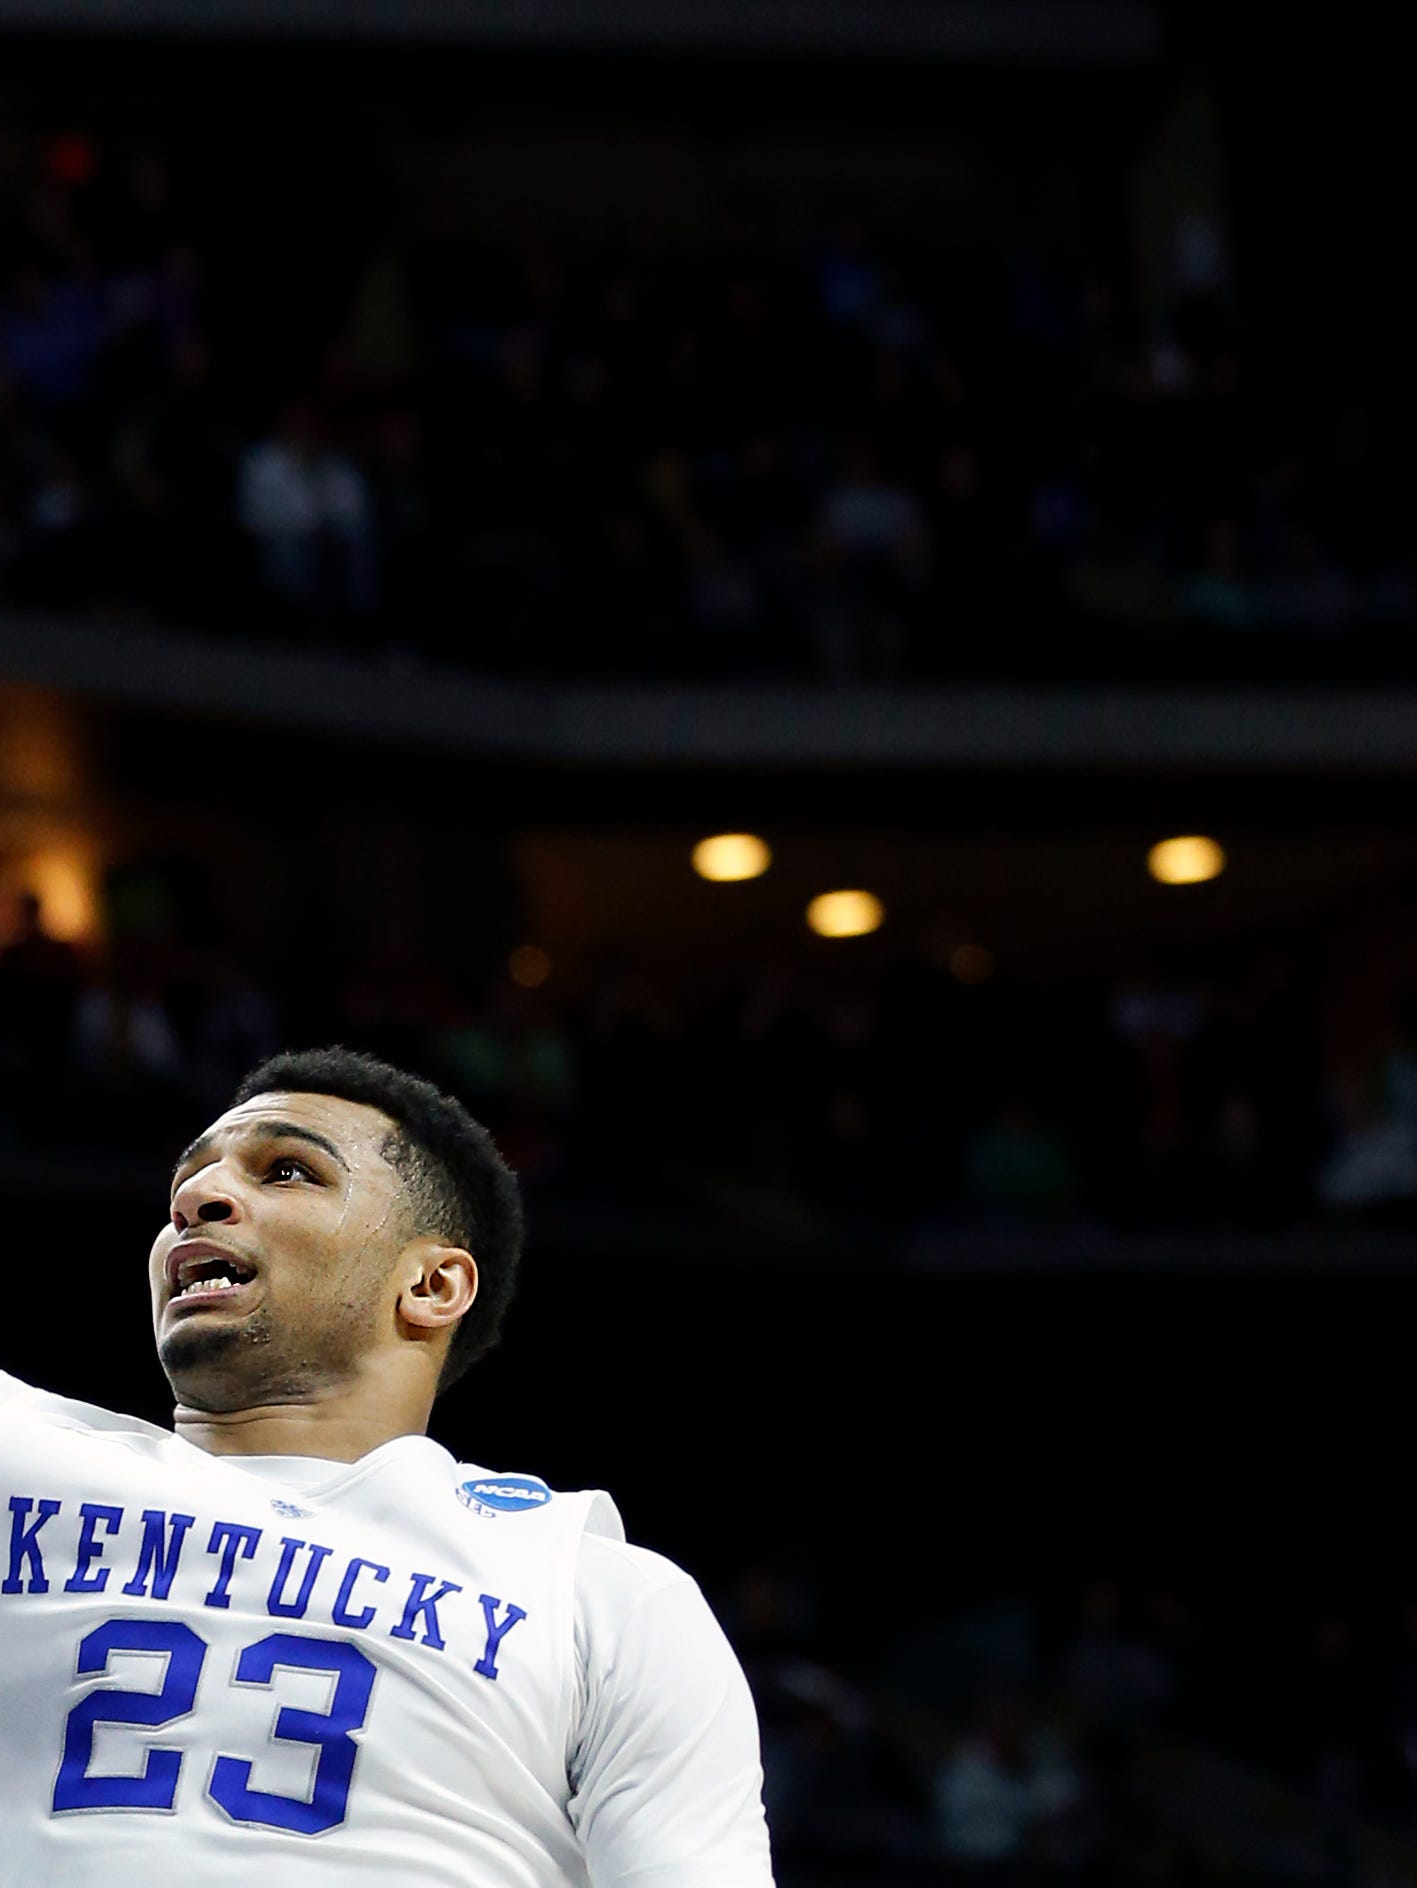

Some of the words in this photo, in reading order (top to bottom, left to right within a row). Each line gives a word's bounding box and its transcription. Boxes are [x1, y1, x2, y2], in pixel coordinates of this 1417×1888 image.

[473, 1484, 546, 1502] NCAA
[1, 1496, 526, 1681] KENTUCKY
[50, 1618, 378, 1839] 23
